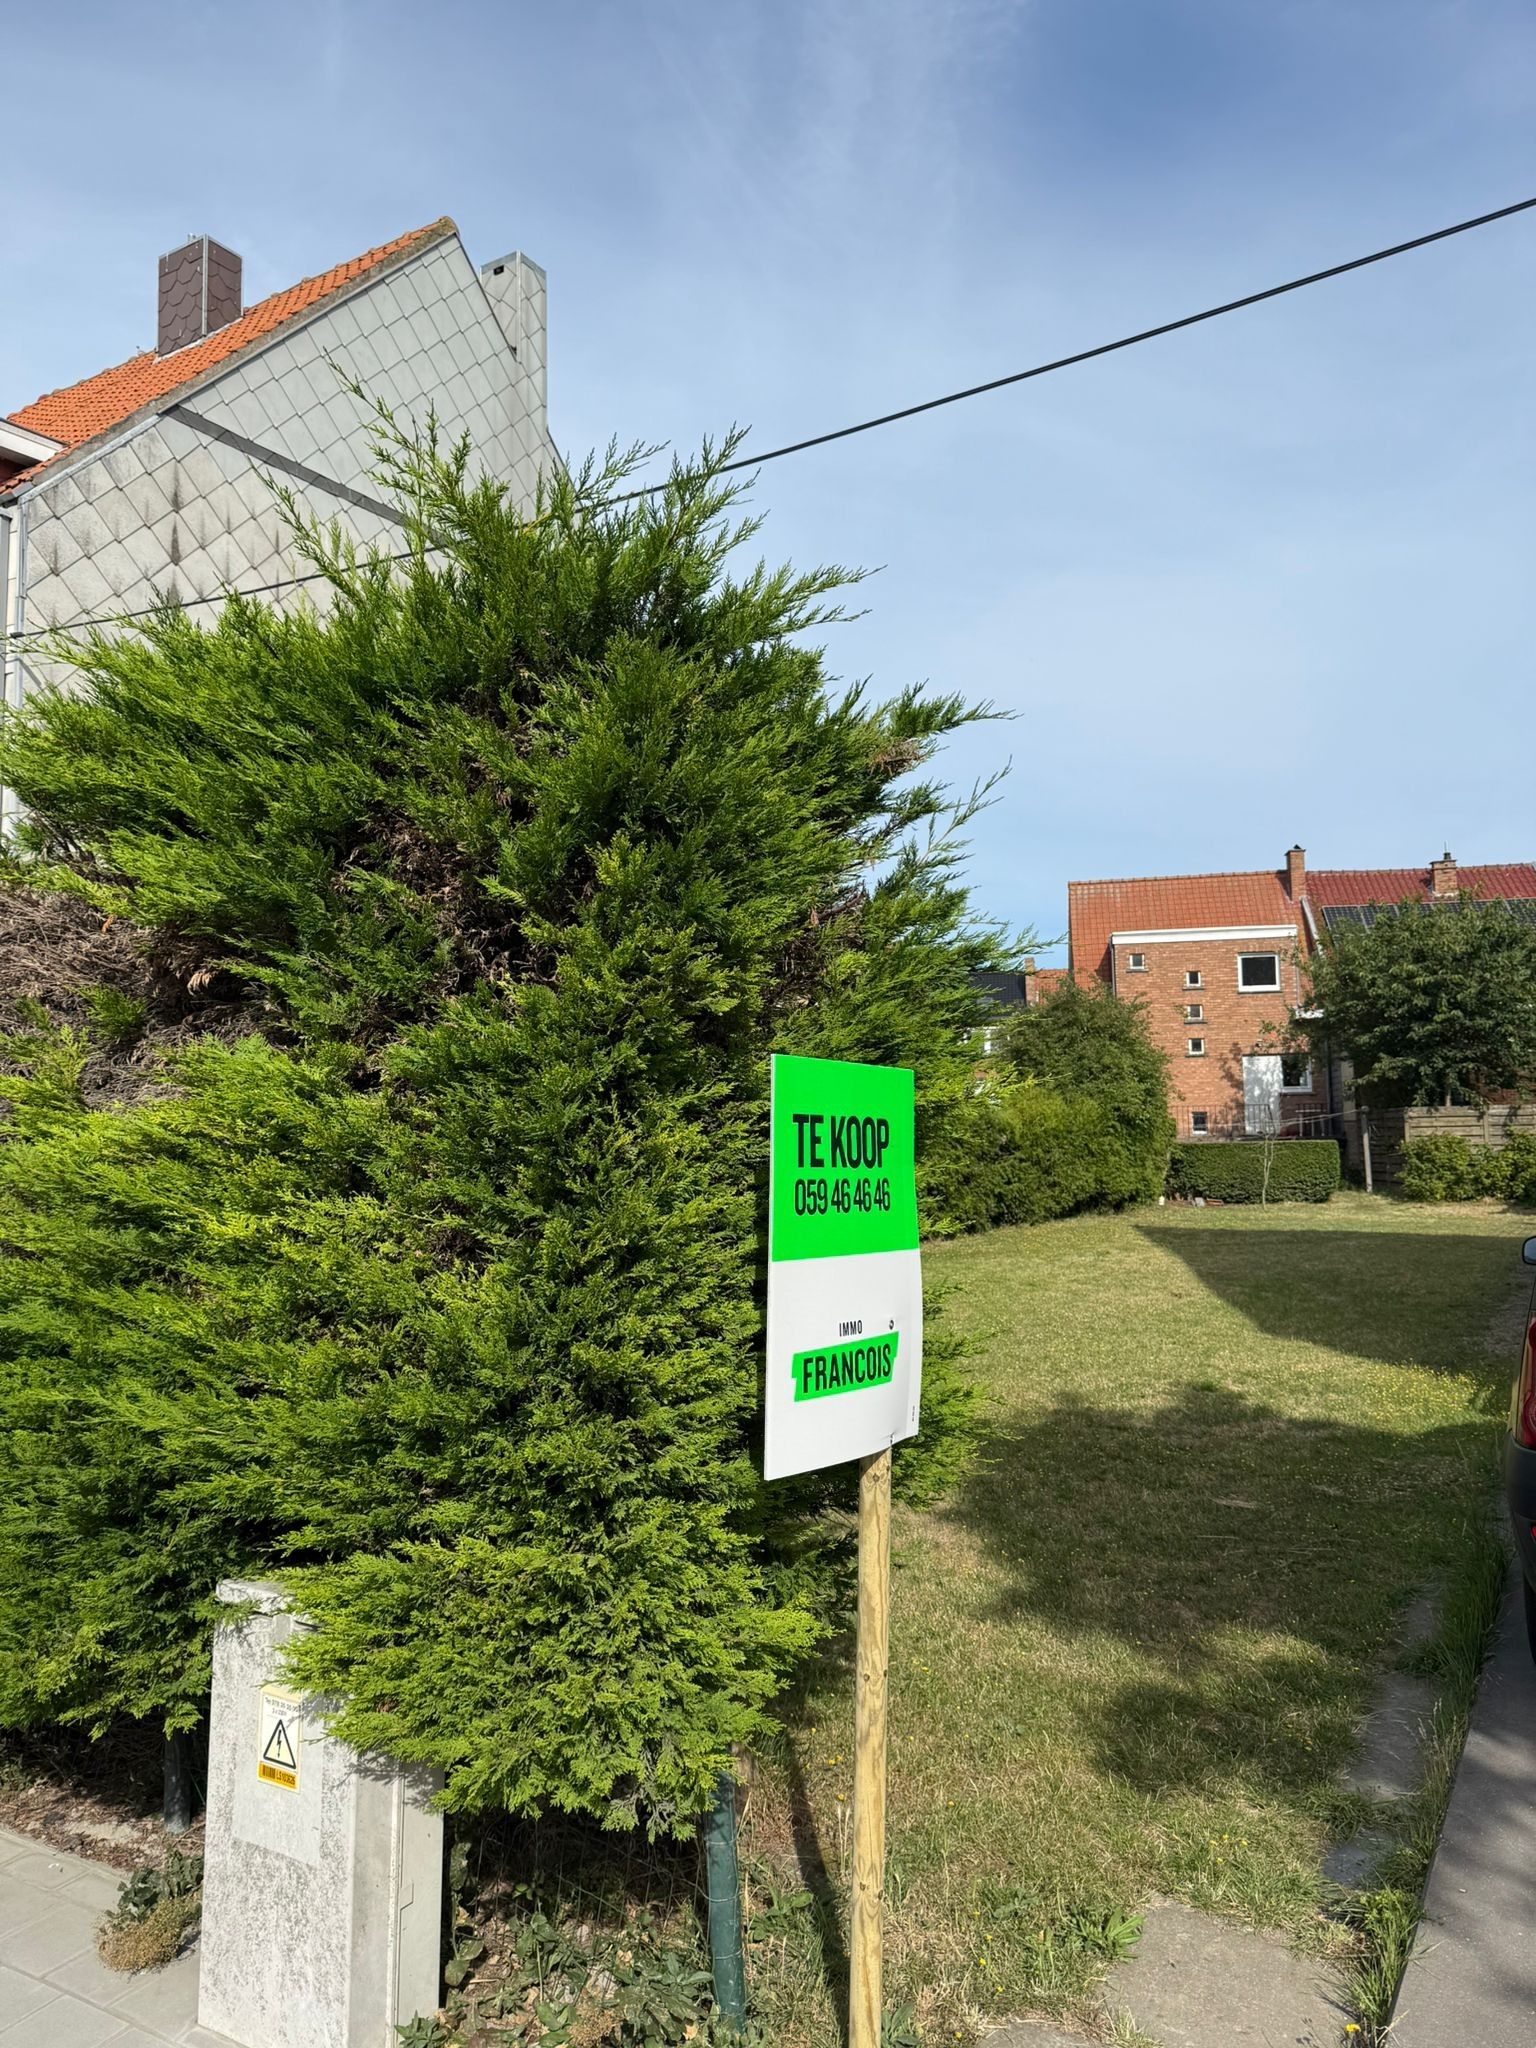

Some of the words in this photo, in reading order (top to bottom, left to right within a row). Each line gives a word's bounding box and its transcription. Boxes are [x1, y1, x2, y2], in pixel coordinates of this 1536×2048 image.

[793, 1113, 824, 1168] TE
[831, 1115, 889, 1169] KOOP
[795, 1178, 828, 1216] 059
[831, 1178, 850, 1213] 46
[853, 1177, 872, 1212] 46
[874, 1177, 891, 1212] 46
[839, 1319, 863, 1337] IMMO
[803, 1343, 891, 1394] FRANCOIS
